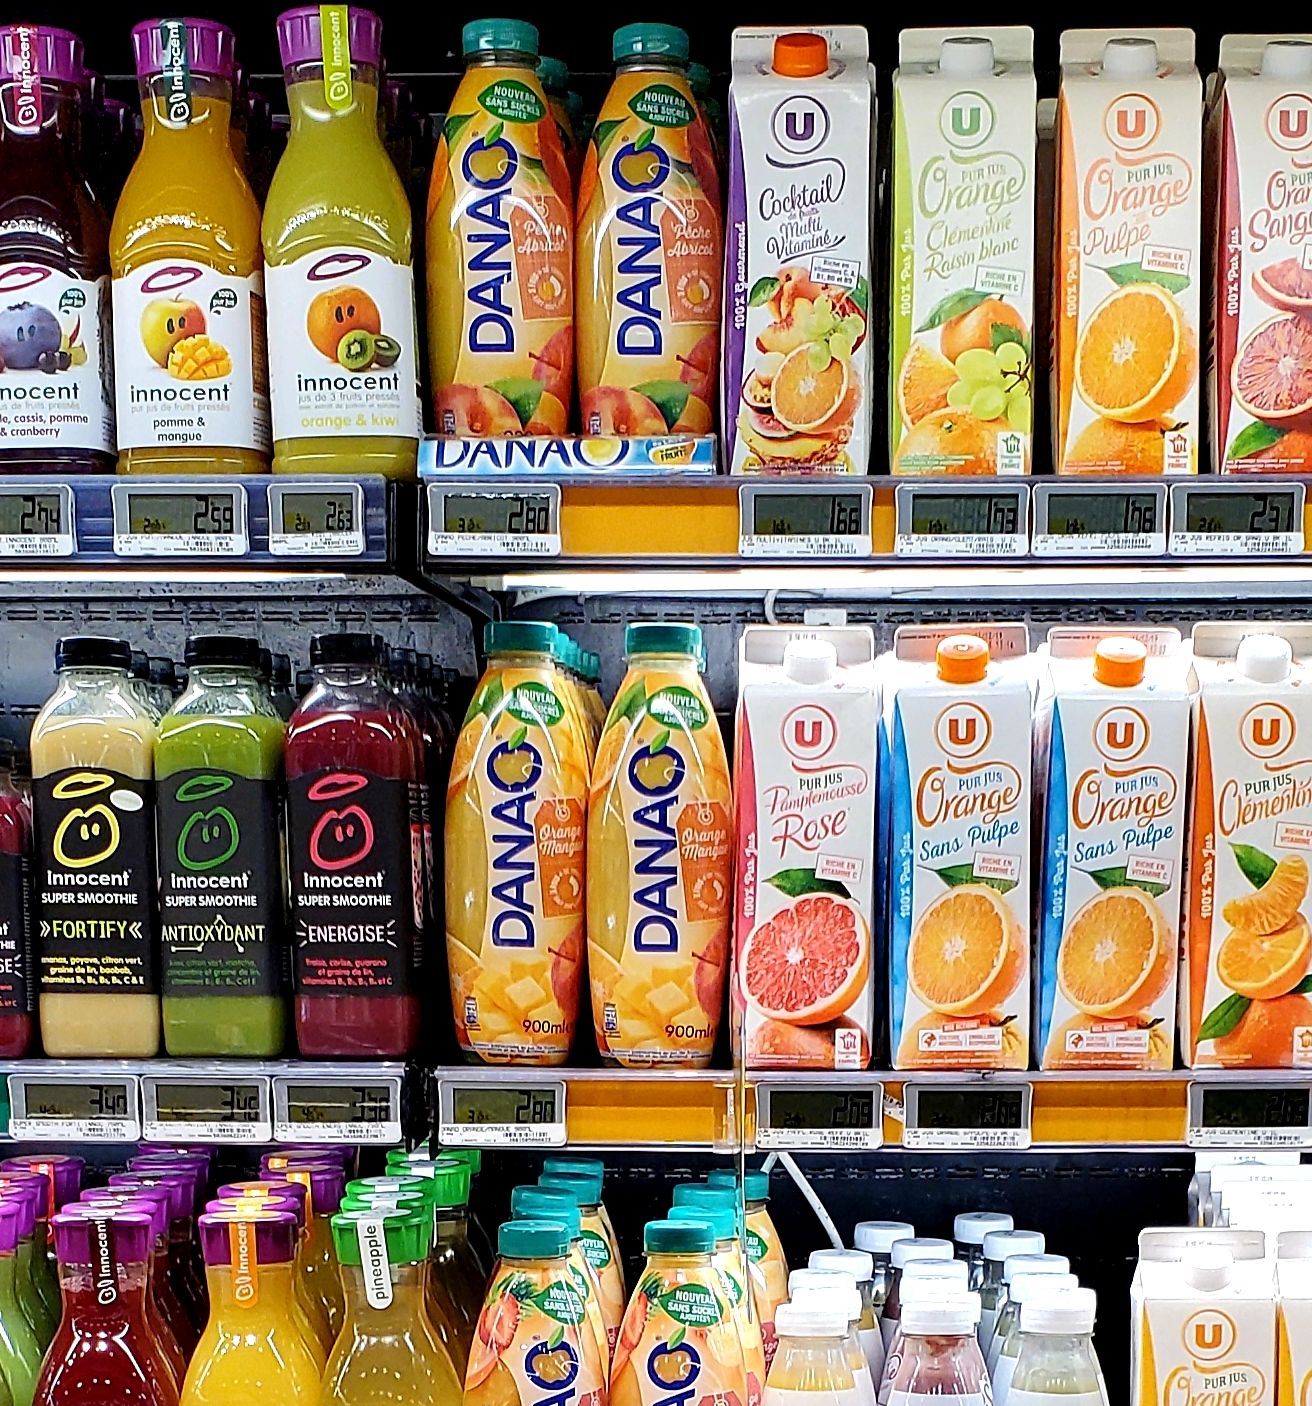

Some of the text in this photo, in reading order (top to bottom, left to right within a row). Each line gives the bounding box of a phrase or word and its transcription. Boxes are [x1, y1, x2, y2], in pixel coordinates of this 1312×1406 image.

[329, 11, 341, 70] innocent
[644, 90, 686, 107] NOUVEAU
[919, 151, 1026, 219] Orange
[1290, 173, 1312, 186] PUR
[759, 172, 845, 221] Cocktail
[779, 218, 822, 245] Multi
[926, 210, 1012, 252] Clémentine
[1085, 221, 1151, 256] Pulpe
[612, 139, 670, 356] DANAO
[668, 240, 714, 258] Abricot
[925, 236, 1019, 280] Raisin blanc
[297, 373, 400, 393] innocent
[49, 412, 88, 424] pomme
[301, 412, 399, 430] orange kiwi
[11, 424, 60, 439] cranberry
[158, 431, 202, 443] mangue
[799, 773, 842, 790] PUR JUS
[764, 778, 866, 811] Pamplemousse
[916, 763, 1021, 824] Orange
[682, 827, 726, 844] Orange
[773, 811, 847, 858] Rose
[920, 820, 1020, 861] Sans Pulpe
[629, 744, 686, 952] DANAO
[682, 841, 728, 861] Mangue
[47, 870, 129, 888] innocent
[41, 893, 138, 906] SUPER SMOOTHIE
[52, 921, 127, 940] FORTIFY
[161, 917, 266, 951] ANTIOXYDANT
[307, 924, 386, 943] ENERGISE
[365, 1224, 384, 1300] pineapple
